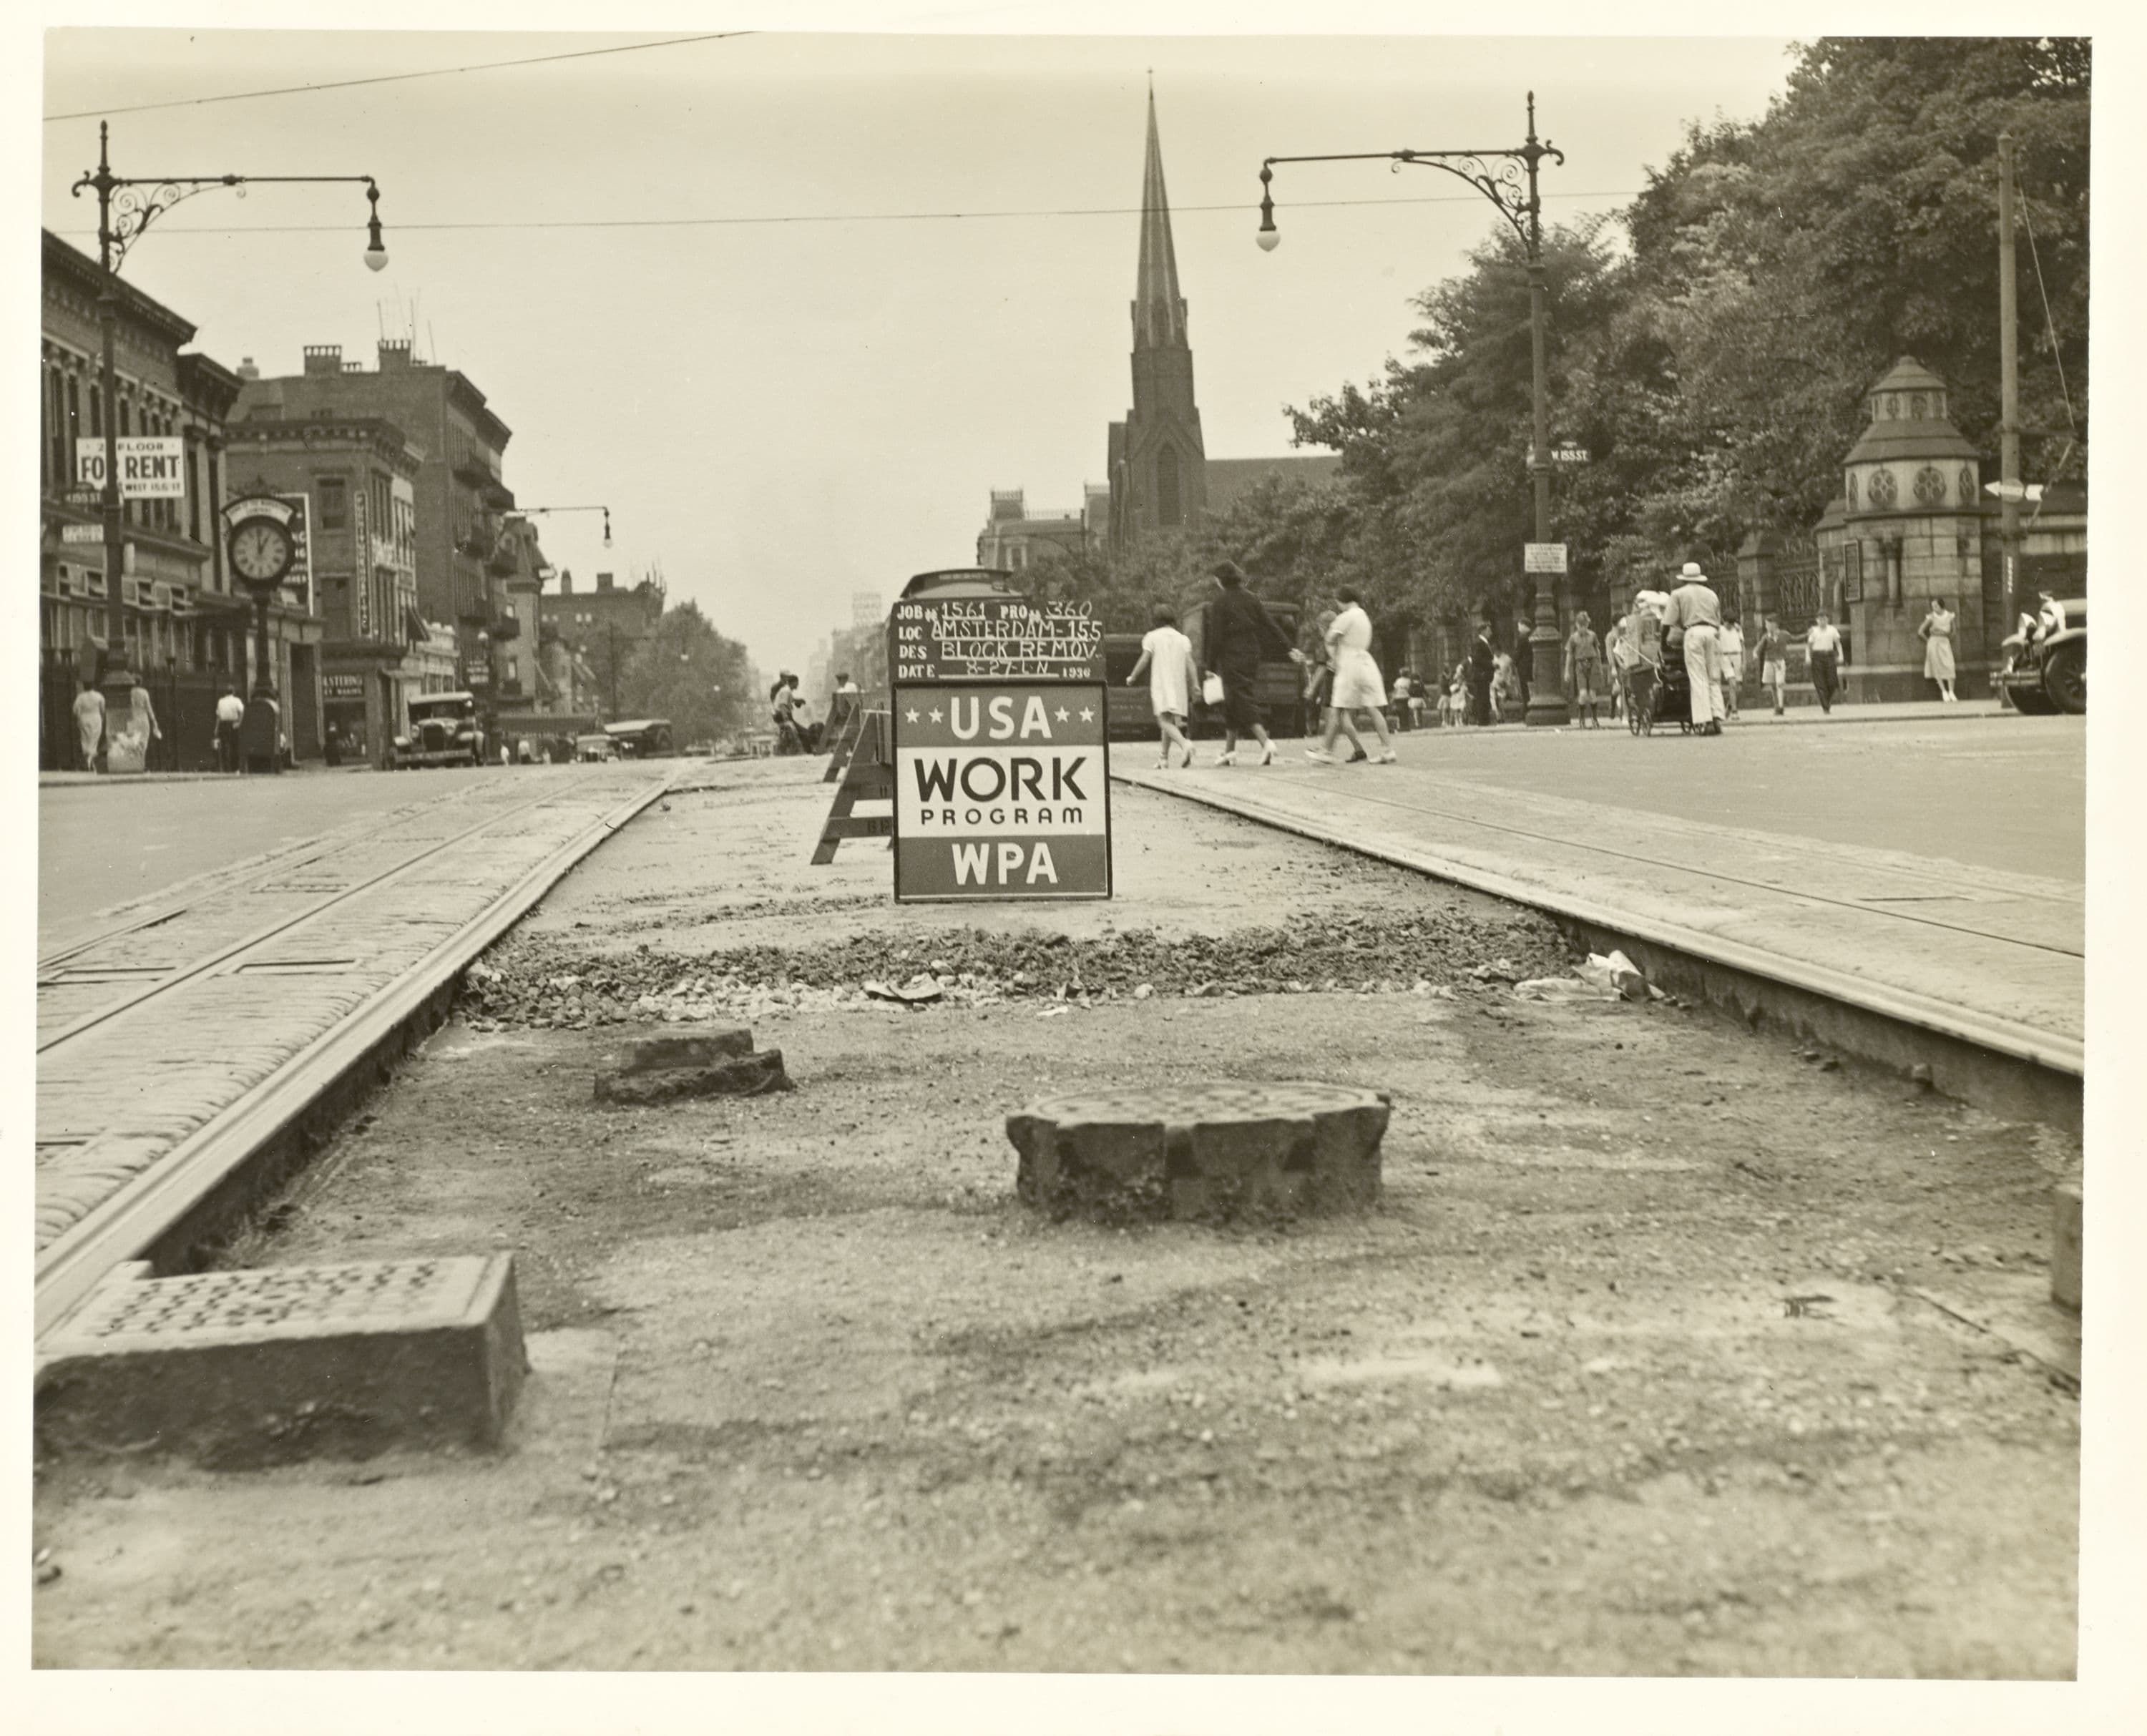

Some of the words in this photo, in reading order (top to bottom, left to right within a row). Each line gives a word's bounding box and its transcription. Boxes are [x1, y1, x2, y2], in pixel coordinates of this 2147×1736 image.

[117, 442, 164, 451] FLOOR
[81, 456, 106, 480] FO
[125, 455, 180, 479] RENT
[942, 602, 986, 620] 1561
[1046, 600, 1092, 619] 360
[899, 625, 923, 641] LOC
[899, 644, 928, 660] DES
[942, 640, 1009, 660] BLOCK
[898, 663, 936, 679] DATE
[951, 695, 1052, 740] USA
[914, 756, 1087, 803] WORK
[921, 807, 1082, 825] PROGRAM
[952, 842, 1058, 886] WPA
